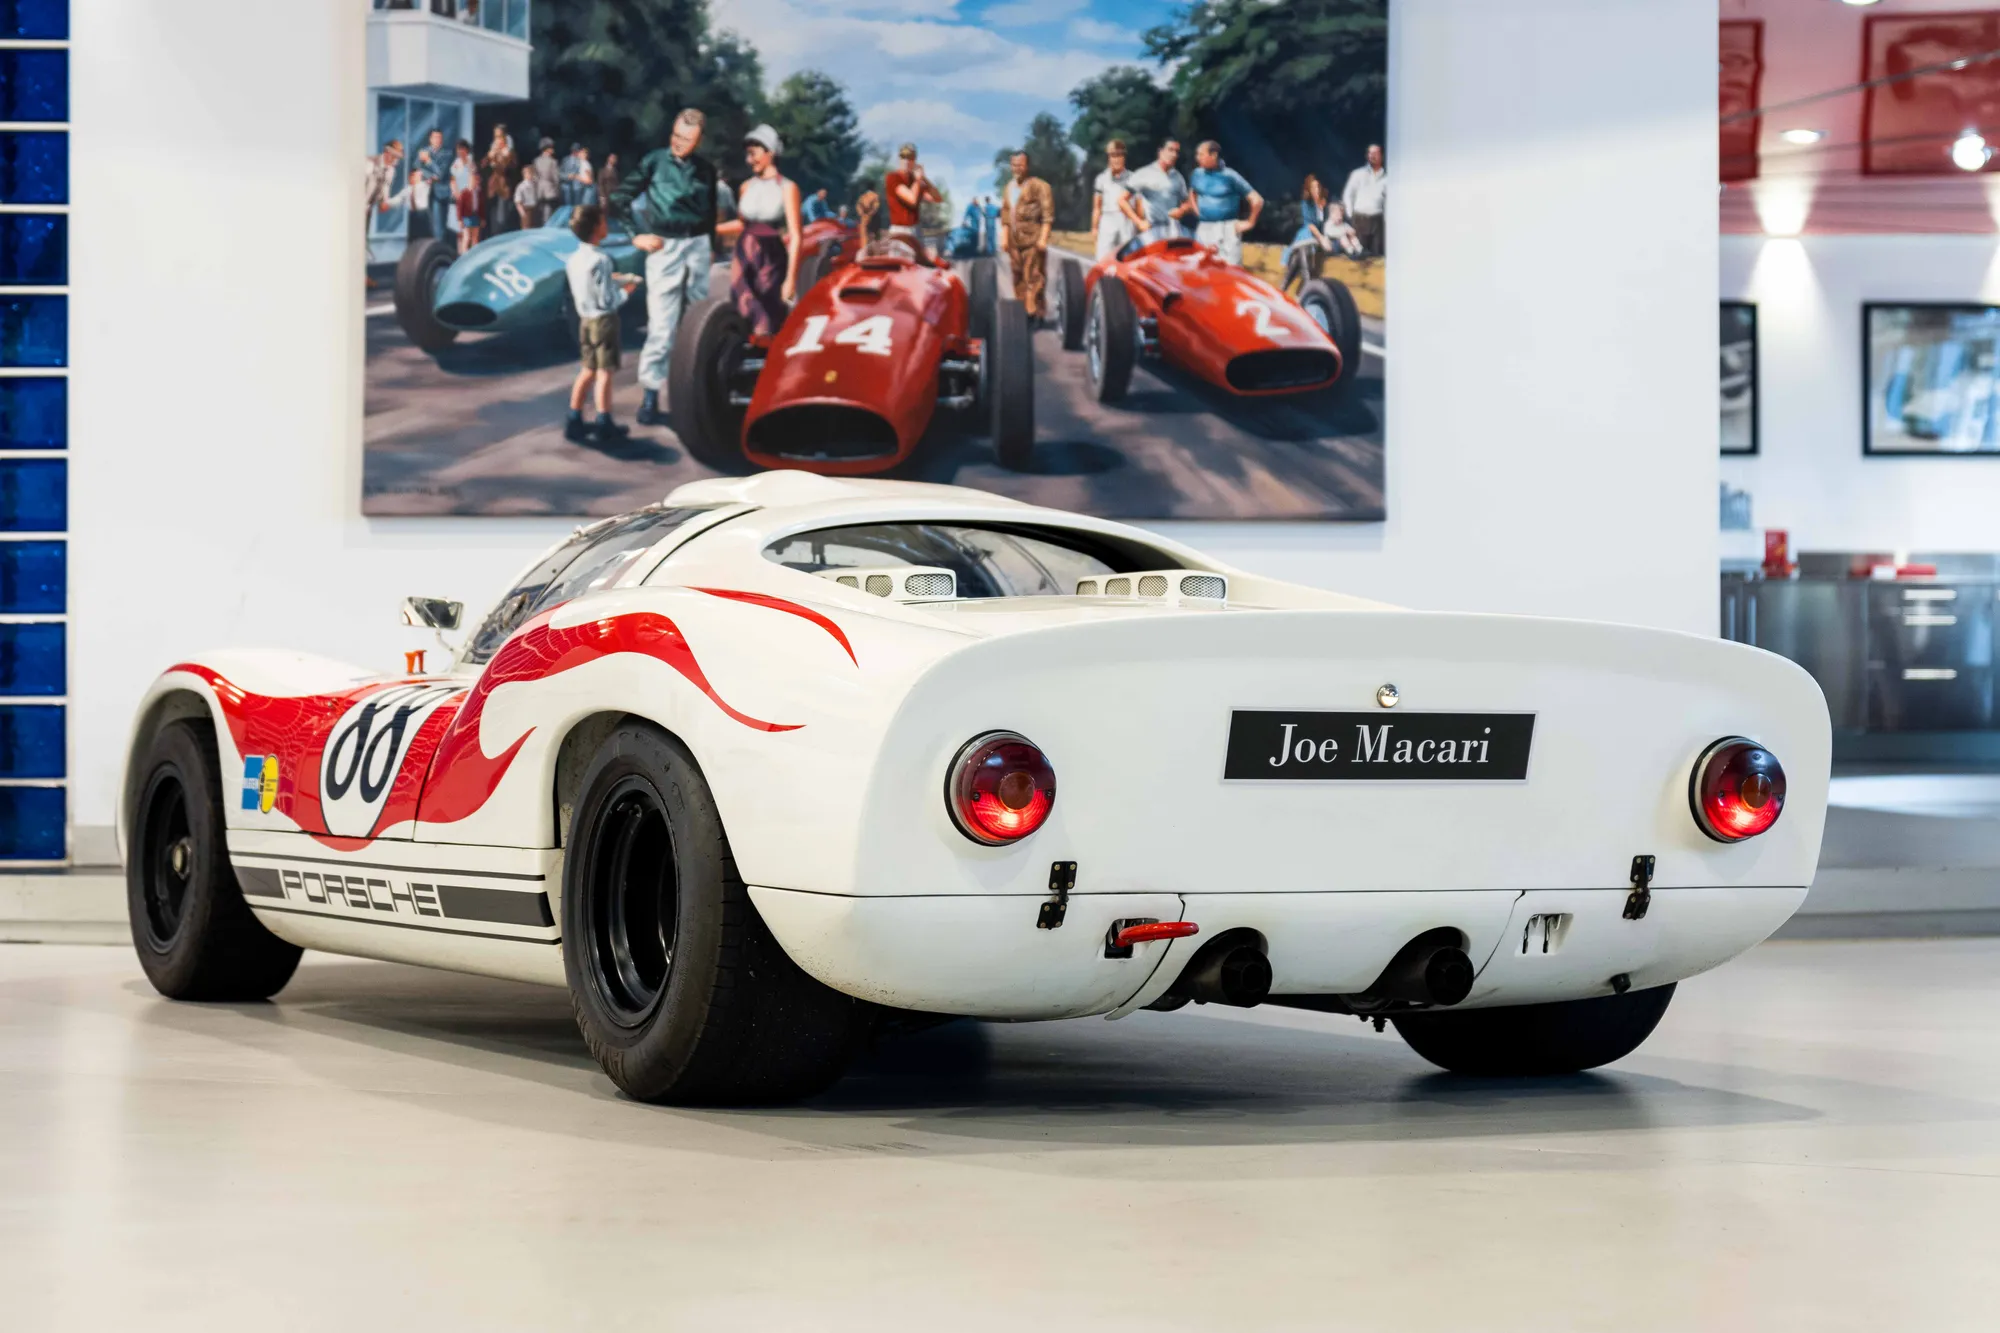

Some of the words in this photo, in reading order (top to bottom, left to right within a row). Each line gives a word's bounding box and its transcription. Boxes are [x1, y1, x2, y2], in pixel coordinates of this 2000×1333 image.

[483, 263, 534, 297] 18
[785, 315, 894, 357] 14
[1236, 300, 1290, 337] 2
[1269, 724, 1338, 767] Joe
[1351, 725, 1491, 763] Macari
[281, 869, 442, 918] PORSCHE
